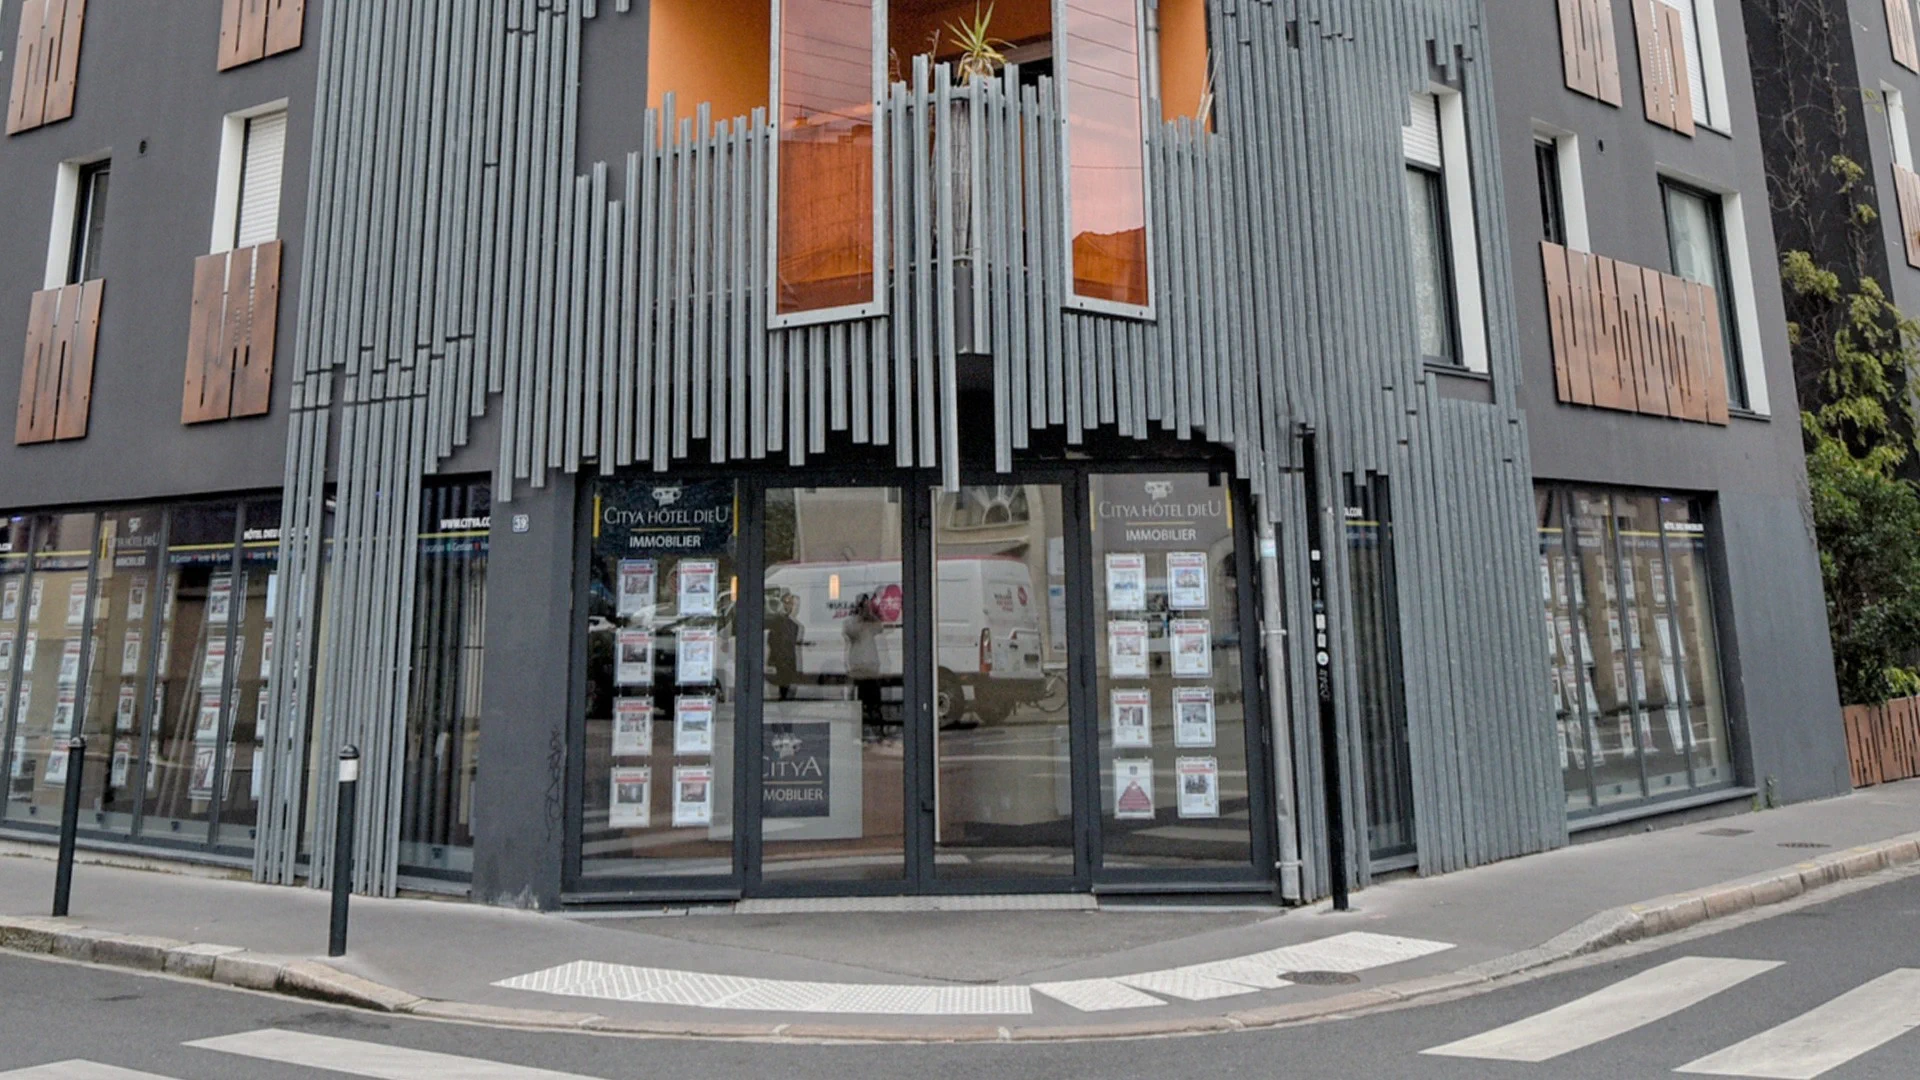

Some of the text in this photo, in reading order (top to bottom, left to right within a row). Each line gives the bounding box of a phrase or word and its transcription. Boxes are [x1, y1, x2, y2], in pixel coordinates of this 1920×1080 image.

[604, 506, 644, 525] CITYA
[647, 508, 691, 525] HÔTEL
[1098, 501, 1139, 518] CITYA
[1142, 501, 1184, 518] HÔTEL
[629, 535, 702, 548] IMMOBILIER
[1125, 528, 1196, 542] IMMOBILIER
